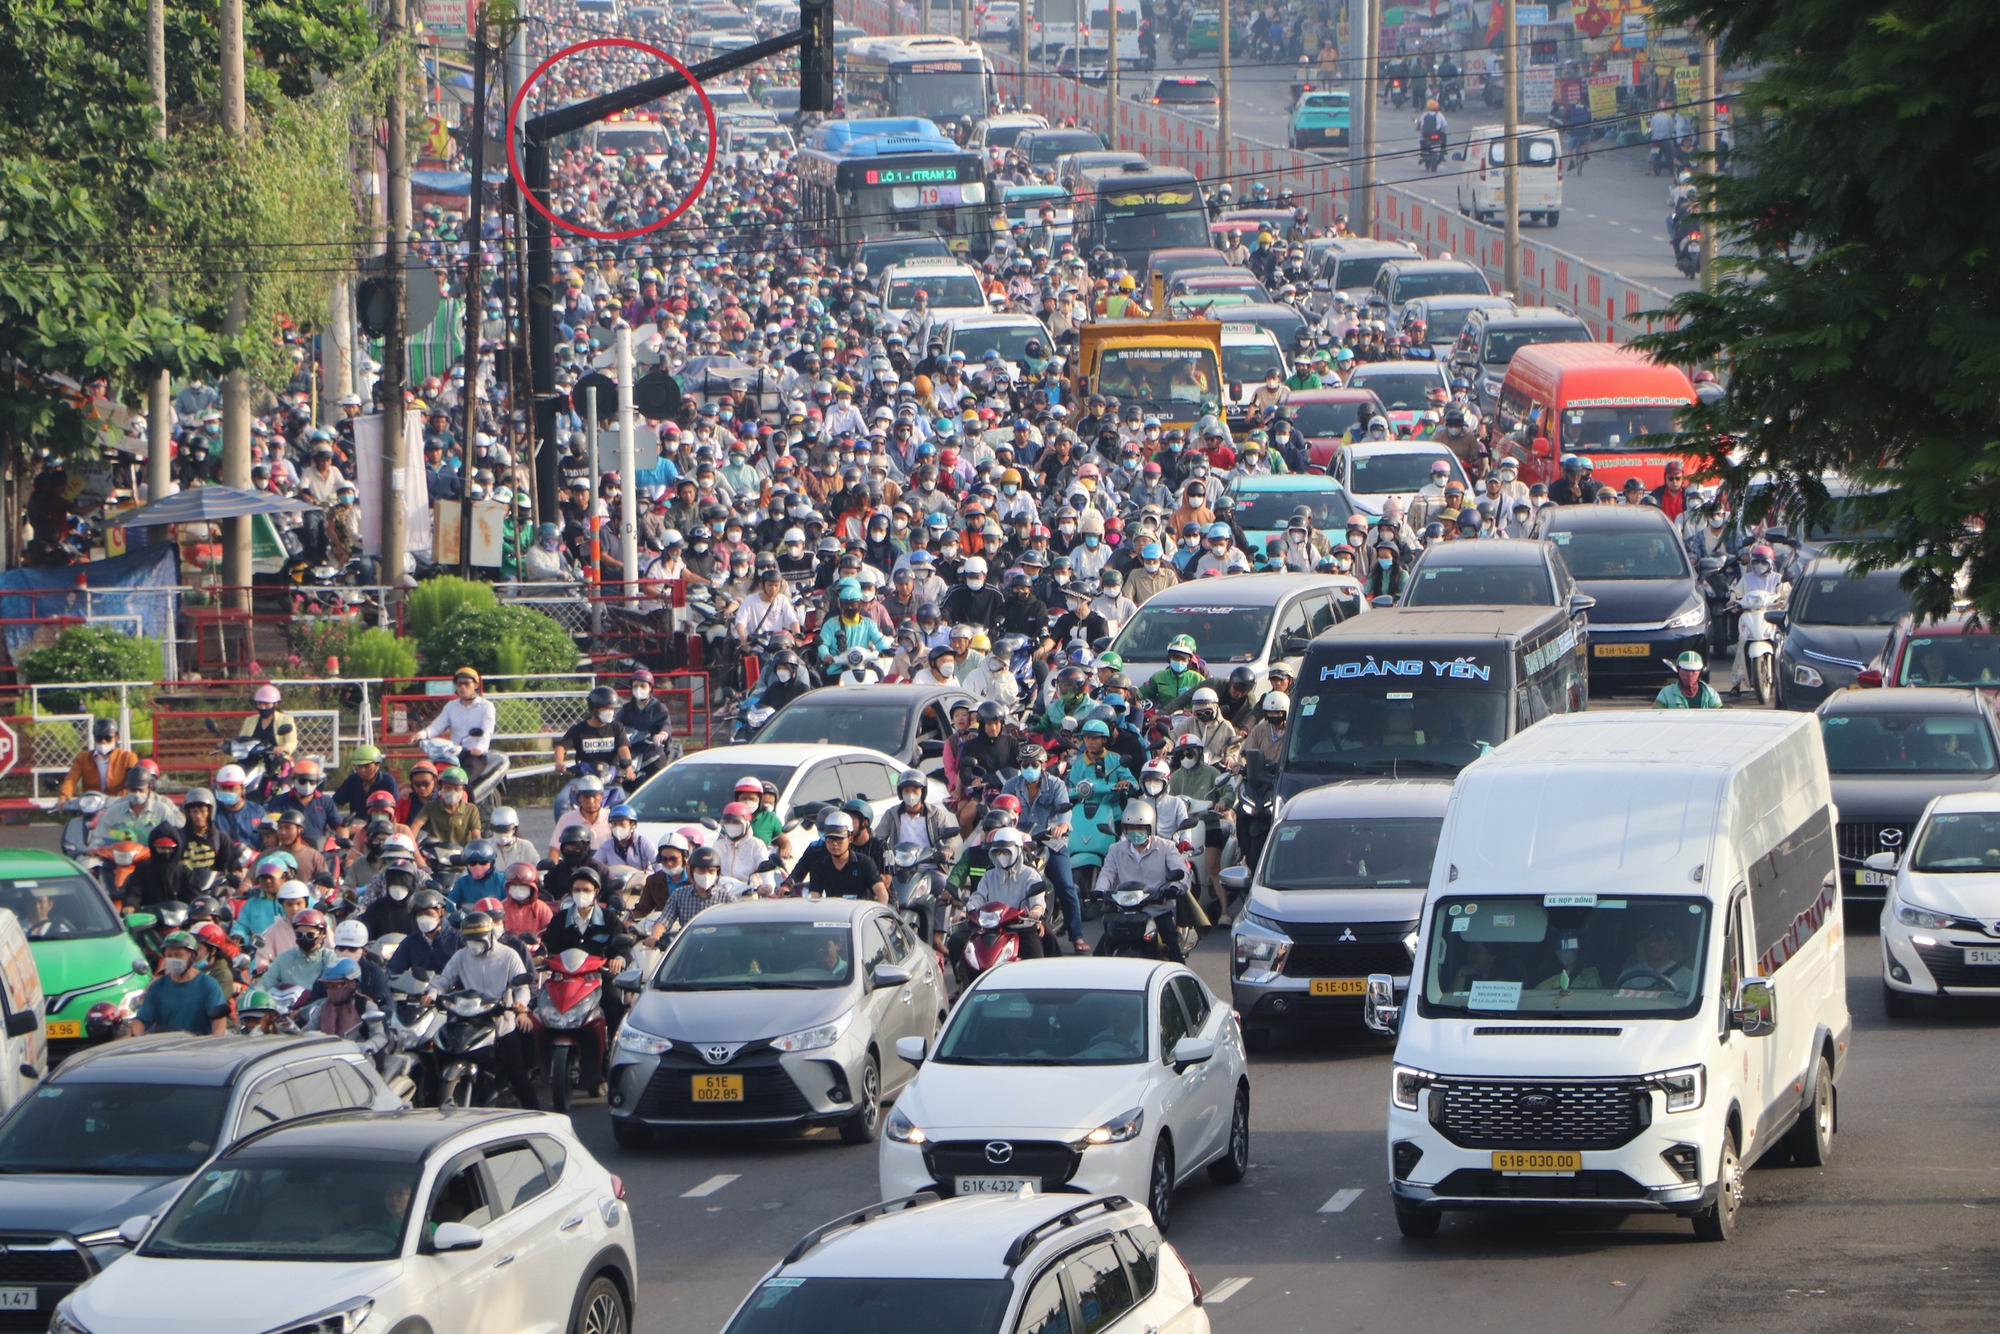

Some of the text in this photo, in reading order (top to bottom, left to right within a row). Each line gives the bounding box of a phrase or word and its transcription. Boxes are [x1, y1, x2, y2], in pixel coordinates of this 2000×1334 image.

[922, 189, 938, 204] 19
[1599, 646, 1645, 655] 61H-146.32
[1319, 655, 1491, 682] HOÀNG YẾN
[584, 741, 614, 749] DICKIES
[1558, 896, 1573, 904] HỢP
[1574, 896, 1593, 904] ĐỒNG
[1316, 981, 1367, 992] 61E-015.
[706, 1076, 729, 1087] 61E
[698, 1089, 738, 1100] 002.85
[1500, 1155, 1574, 1167] 61B-030.00
[962, 1180, 1034, 1192] 61K-432.7
